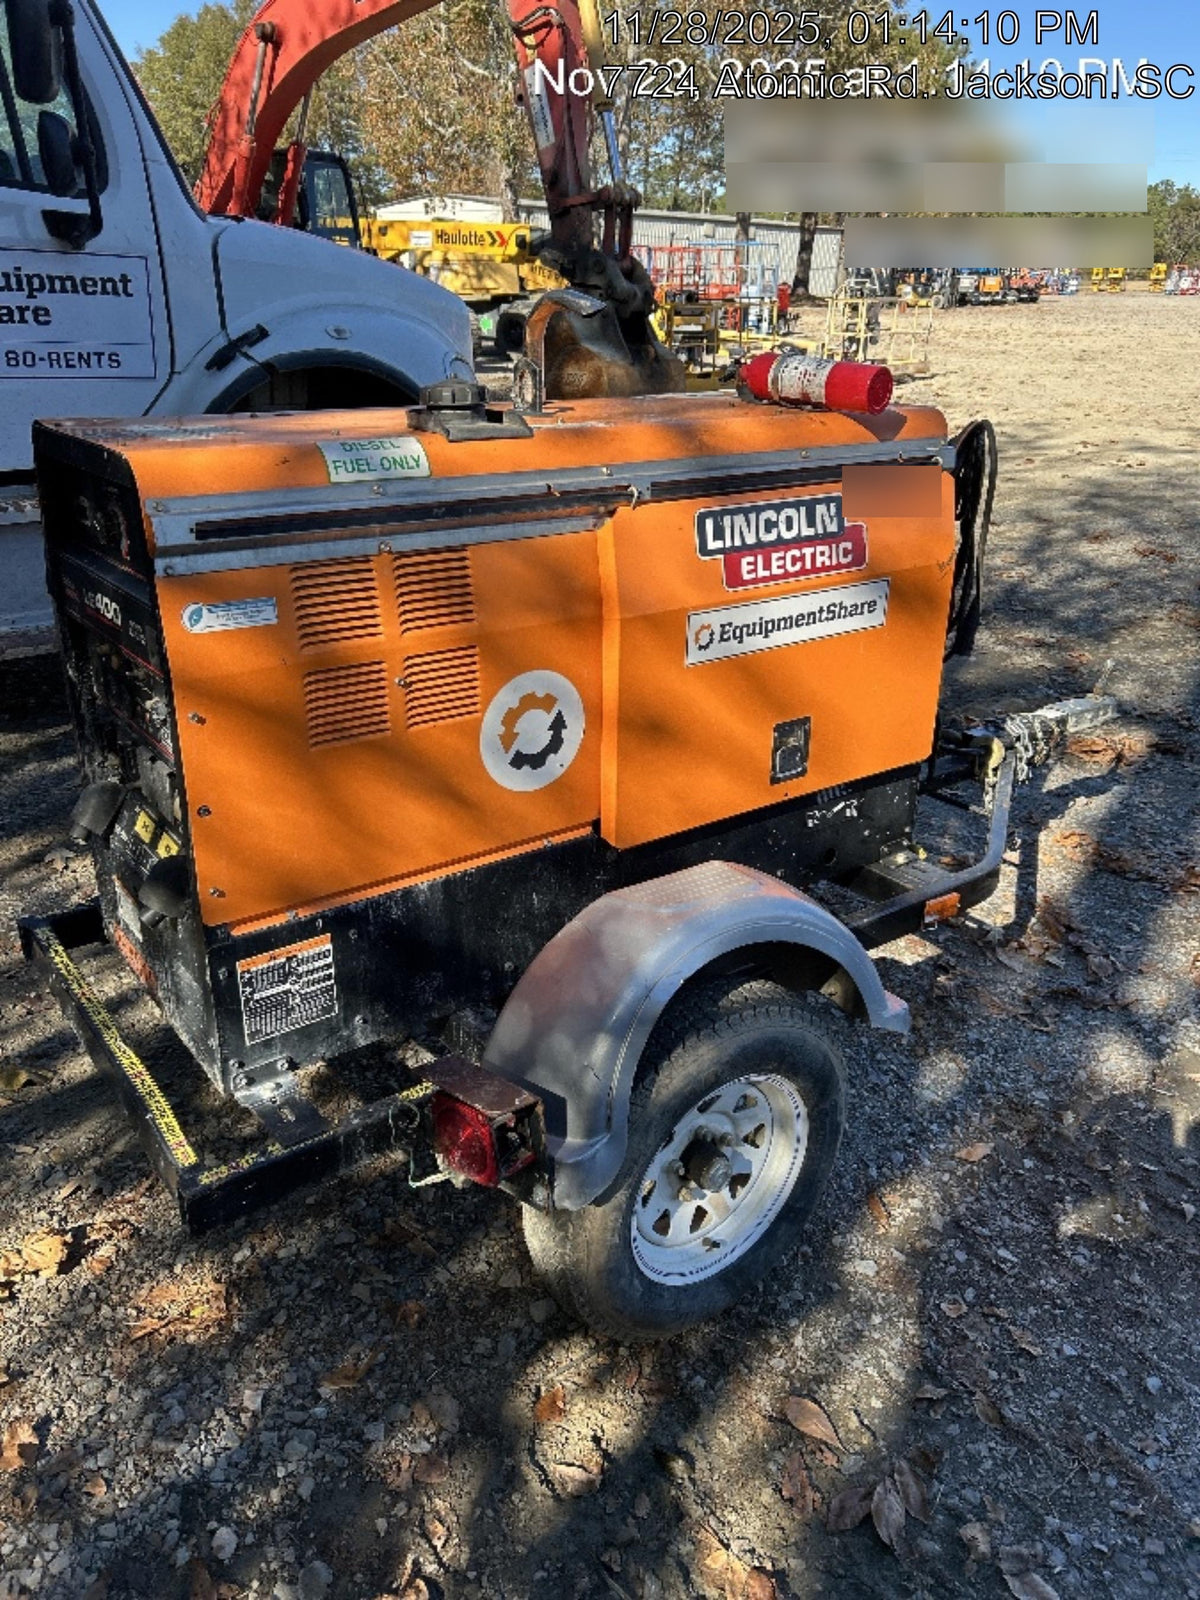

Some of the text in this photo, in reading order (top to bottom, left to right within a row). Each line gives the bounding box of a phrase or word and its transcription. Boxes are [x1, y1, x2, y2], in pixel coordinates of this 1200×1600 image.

[435, 229, 485, 246] Haulotte
[339, 439, 400, 453] DIESEL
[332, 455, 420, 475] FUEL ONLY
[705, 502, 839, 550] LINCOLN
[741, 541, 853, 580] ELECTRIC
[718, 597, 878, 644] EquipmentShare
